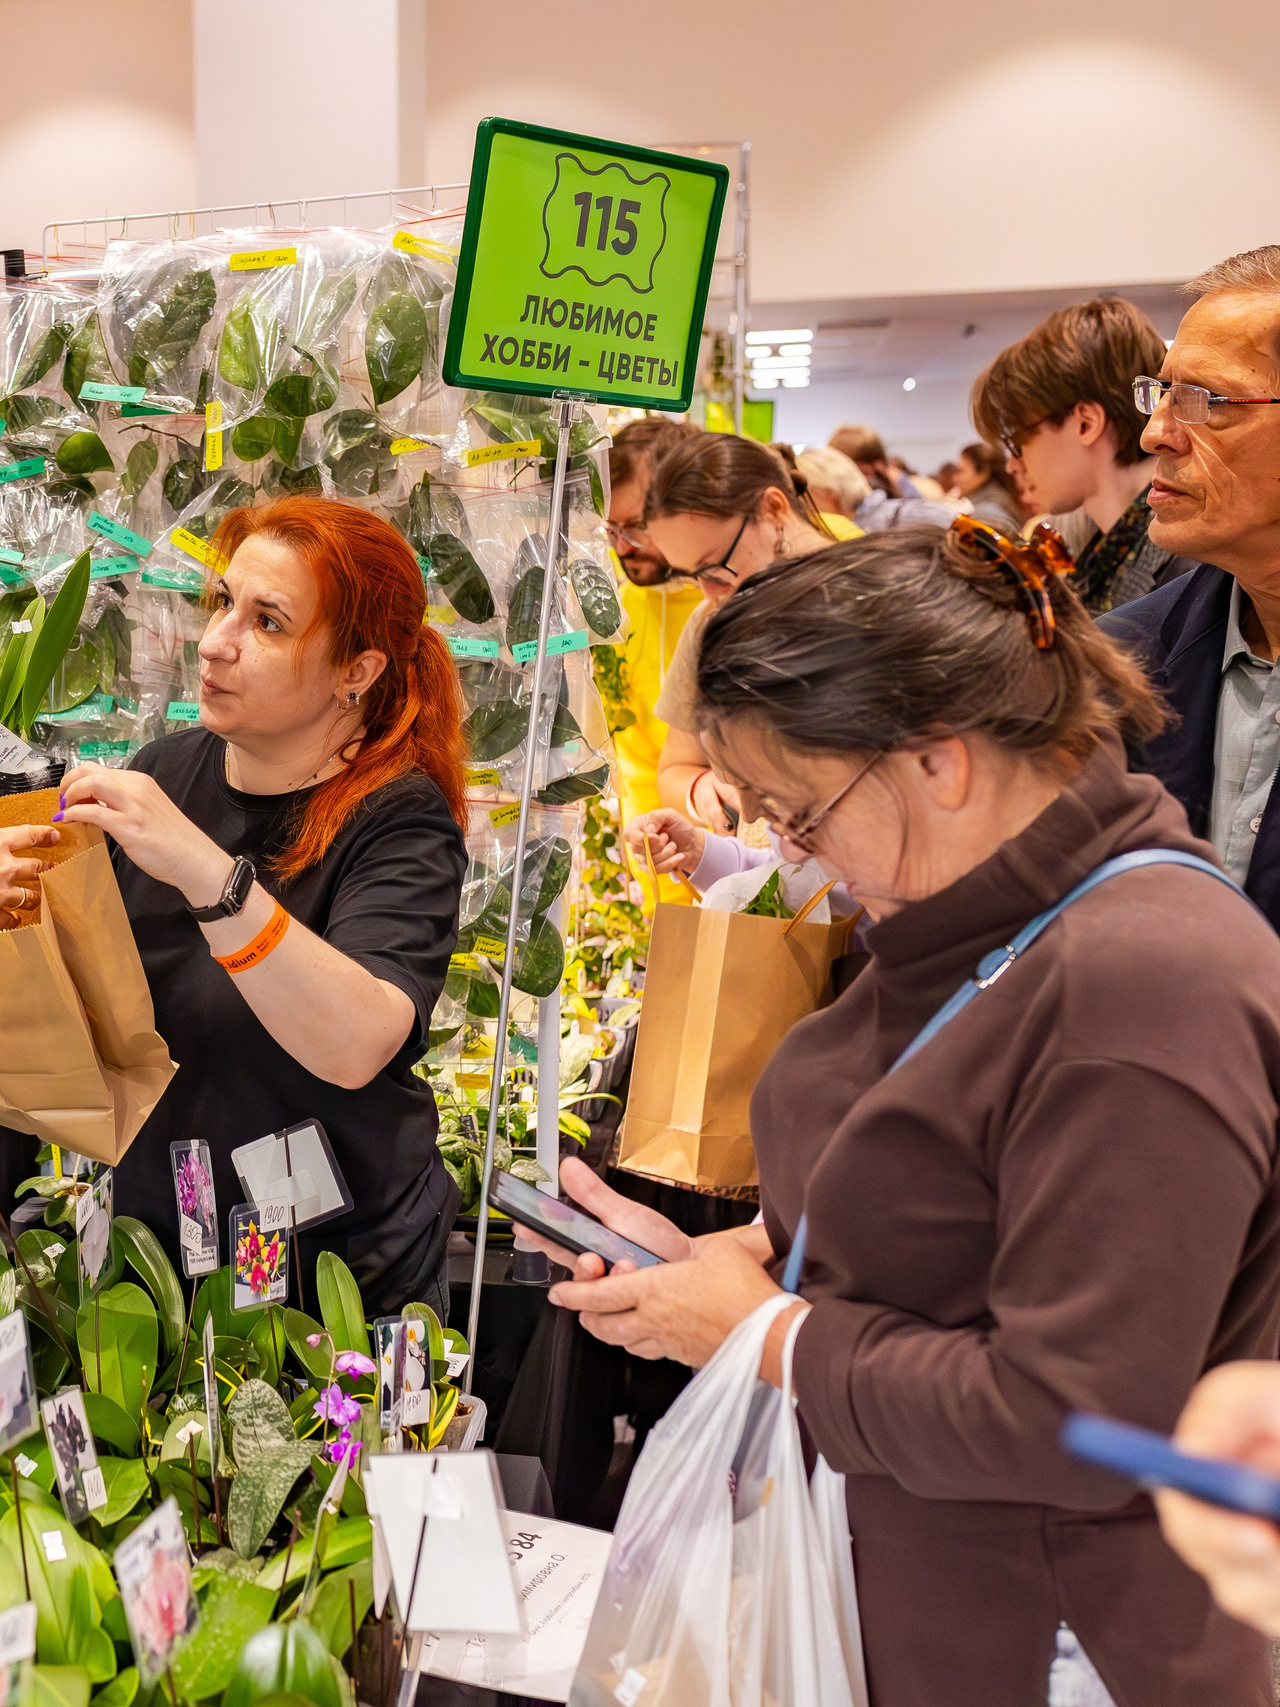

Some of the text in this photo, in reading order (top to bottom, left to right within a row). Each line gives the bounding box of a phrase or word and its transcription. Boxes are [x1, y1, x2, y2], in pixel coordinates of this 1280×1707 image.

[574, 191, 642, 256] 115
[519, 294, 658, 342] ЛЮБИМОЕ
[479, 333, 572, 373] ХОББИ
[597, 350, 679, 388] ЦВЕТЫ
[183, 1222, 202, 1244] 1300
